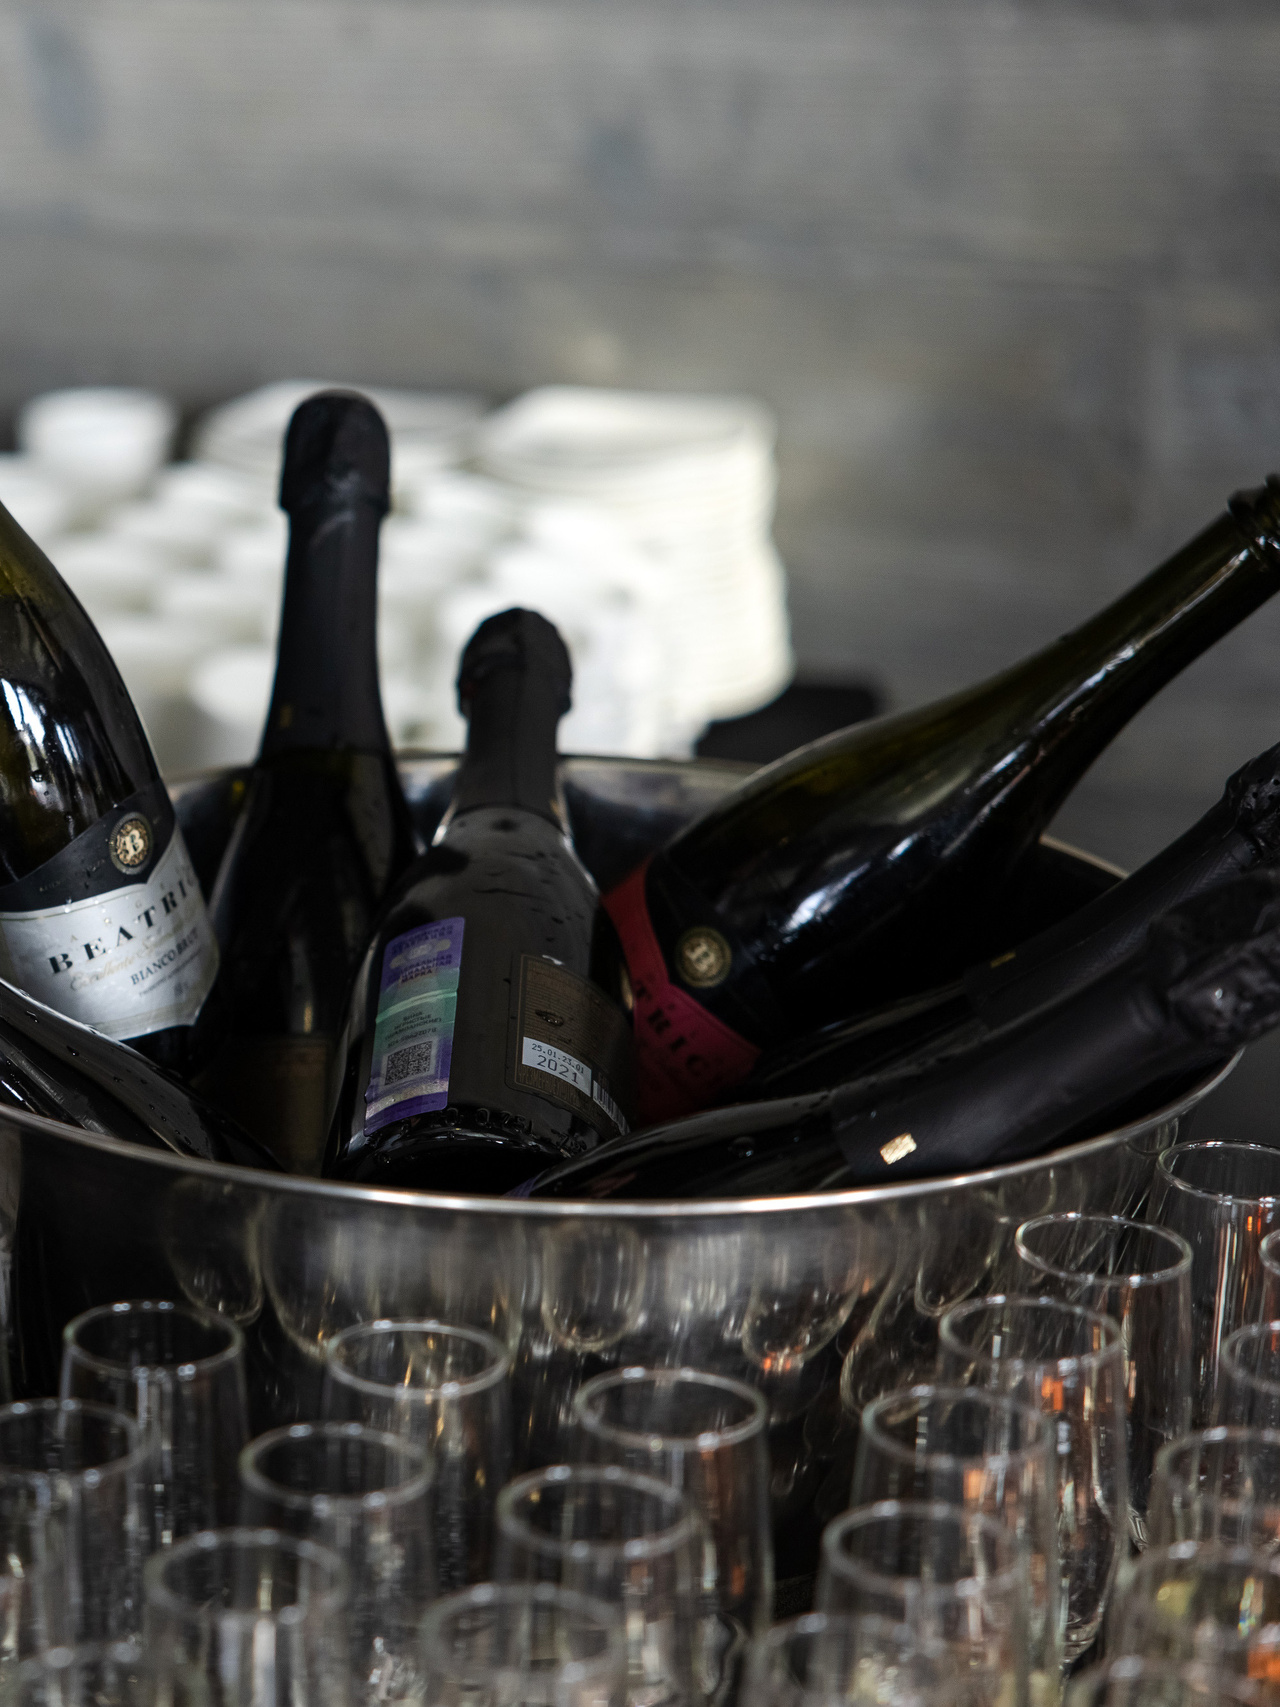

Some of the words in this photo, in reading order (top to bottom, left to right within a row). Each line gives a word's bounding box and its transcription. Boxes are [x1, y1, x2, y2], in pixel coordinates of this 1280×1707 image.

[130, 951, 177, 985] BIANCO
[531, 1043, 584, 1074] 25.01.23.01
[537, 1055, 579, 1085] 2021
